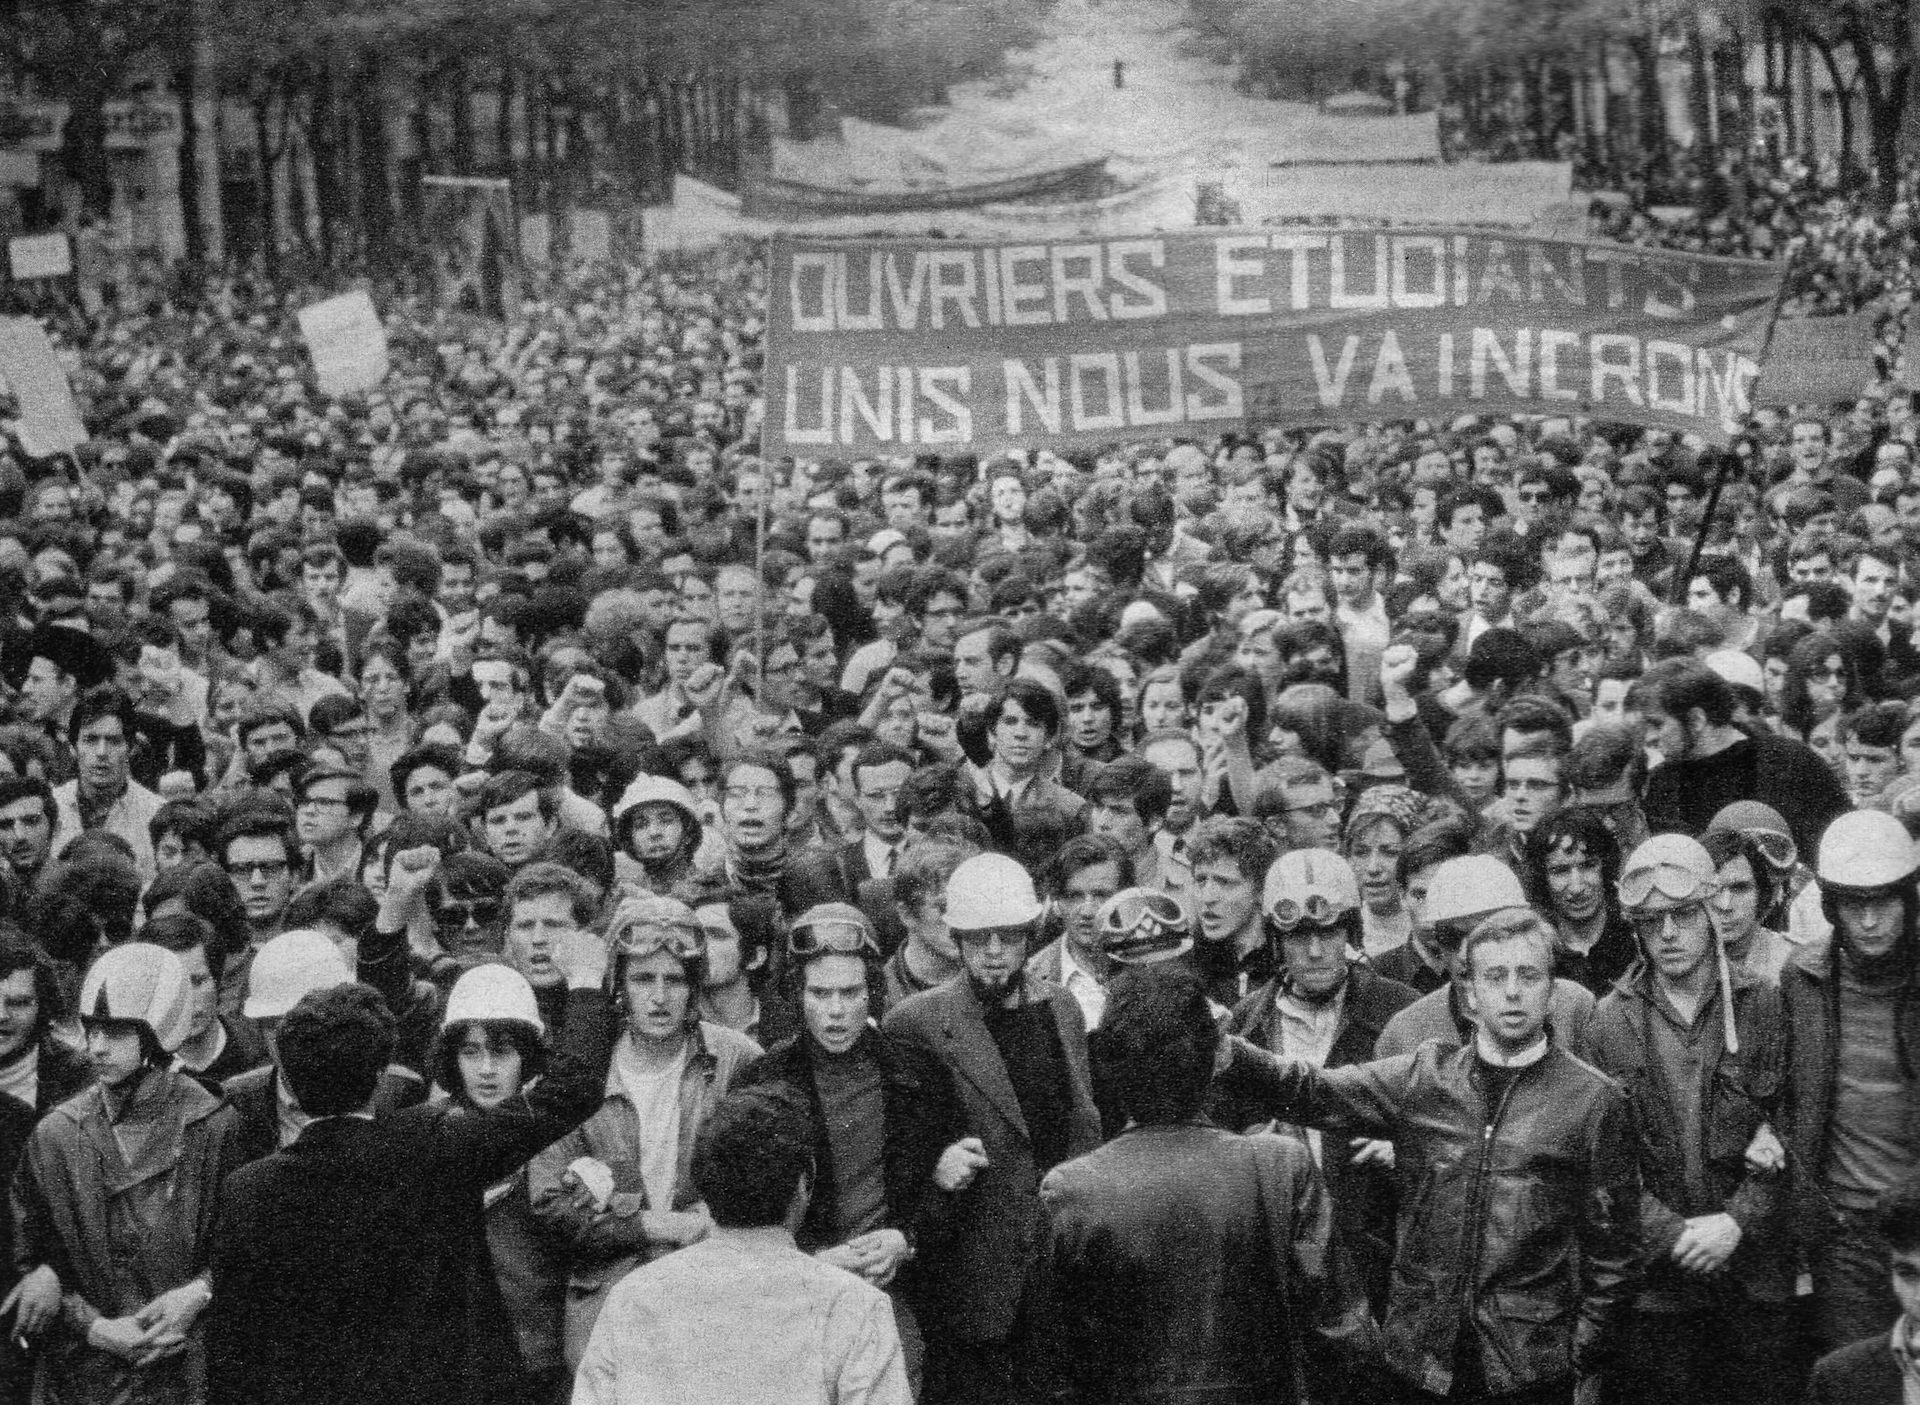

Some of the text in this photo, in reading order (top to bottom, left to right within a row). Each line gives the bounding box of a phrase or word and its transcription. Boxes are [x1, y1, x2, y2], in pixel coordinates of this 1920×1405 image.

[789, 234, 1698, 331] OUVRIERS ETUDIANTS
[785, 363, 972, 444] UNIS
[1003, 342, 1243, 434] NOUS
